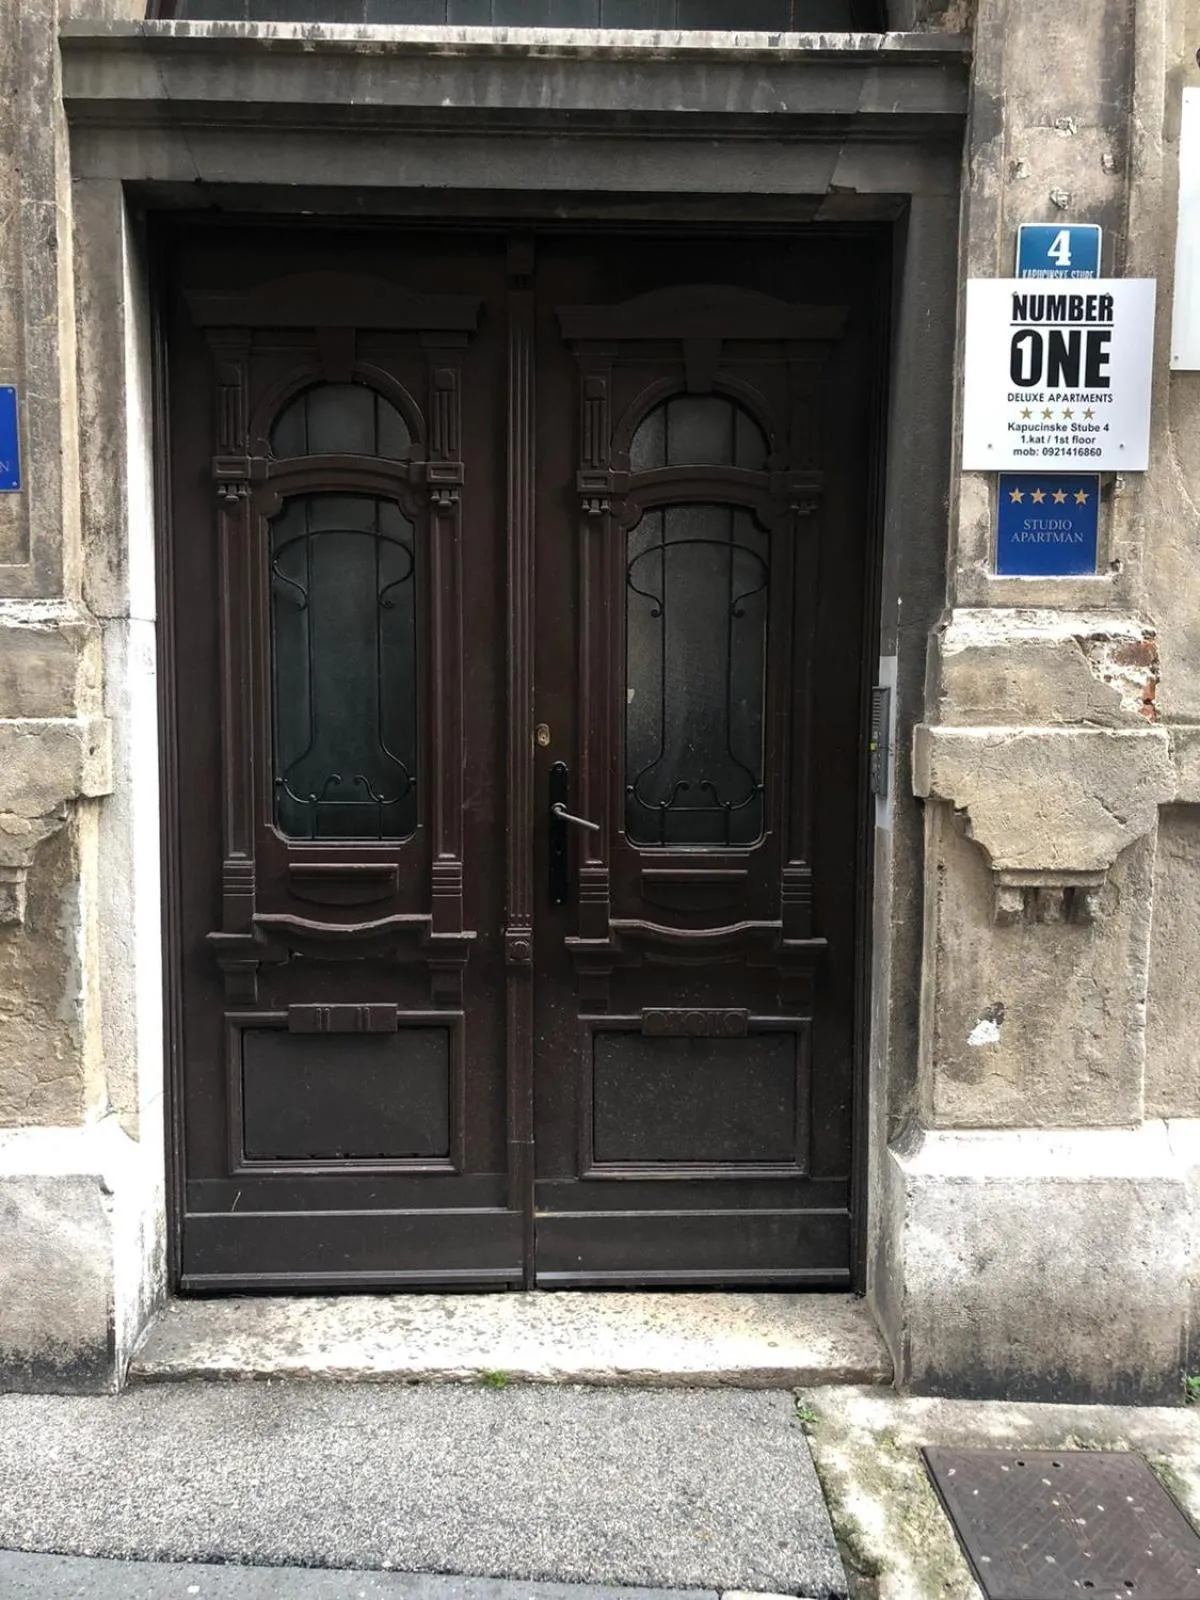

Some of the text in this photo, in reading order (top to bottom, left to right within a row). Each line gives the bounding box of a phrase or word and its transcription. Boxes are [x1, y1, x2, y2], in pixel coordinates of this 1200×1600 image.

[1047, 230, 1072, 266] 4
[1012, 294, 1114, 321] NUMBER
[1010, 329, 1111, 388] ONE
[1007, 393, 1113, 403] DELUXE APARTMENTS
[1008, 422, 1110, 433] Kapucinske Stube 4
[1021, 435, 1045, 444] 1.kat
[1054, 435, 1069, 444] 1st
[1072, 435, 1096, 444] floor
[1013, 447, 1102, 456] mob: 0921416860
[1023, 519, 1072, 530] STUDIO
[1011, 532, 1084, 543] APARTMAN
